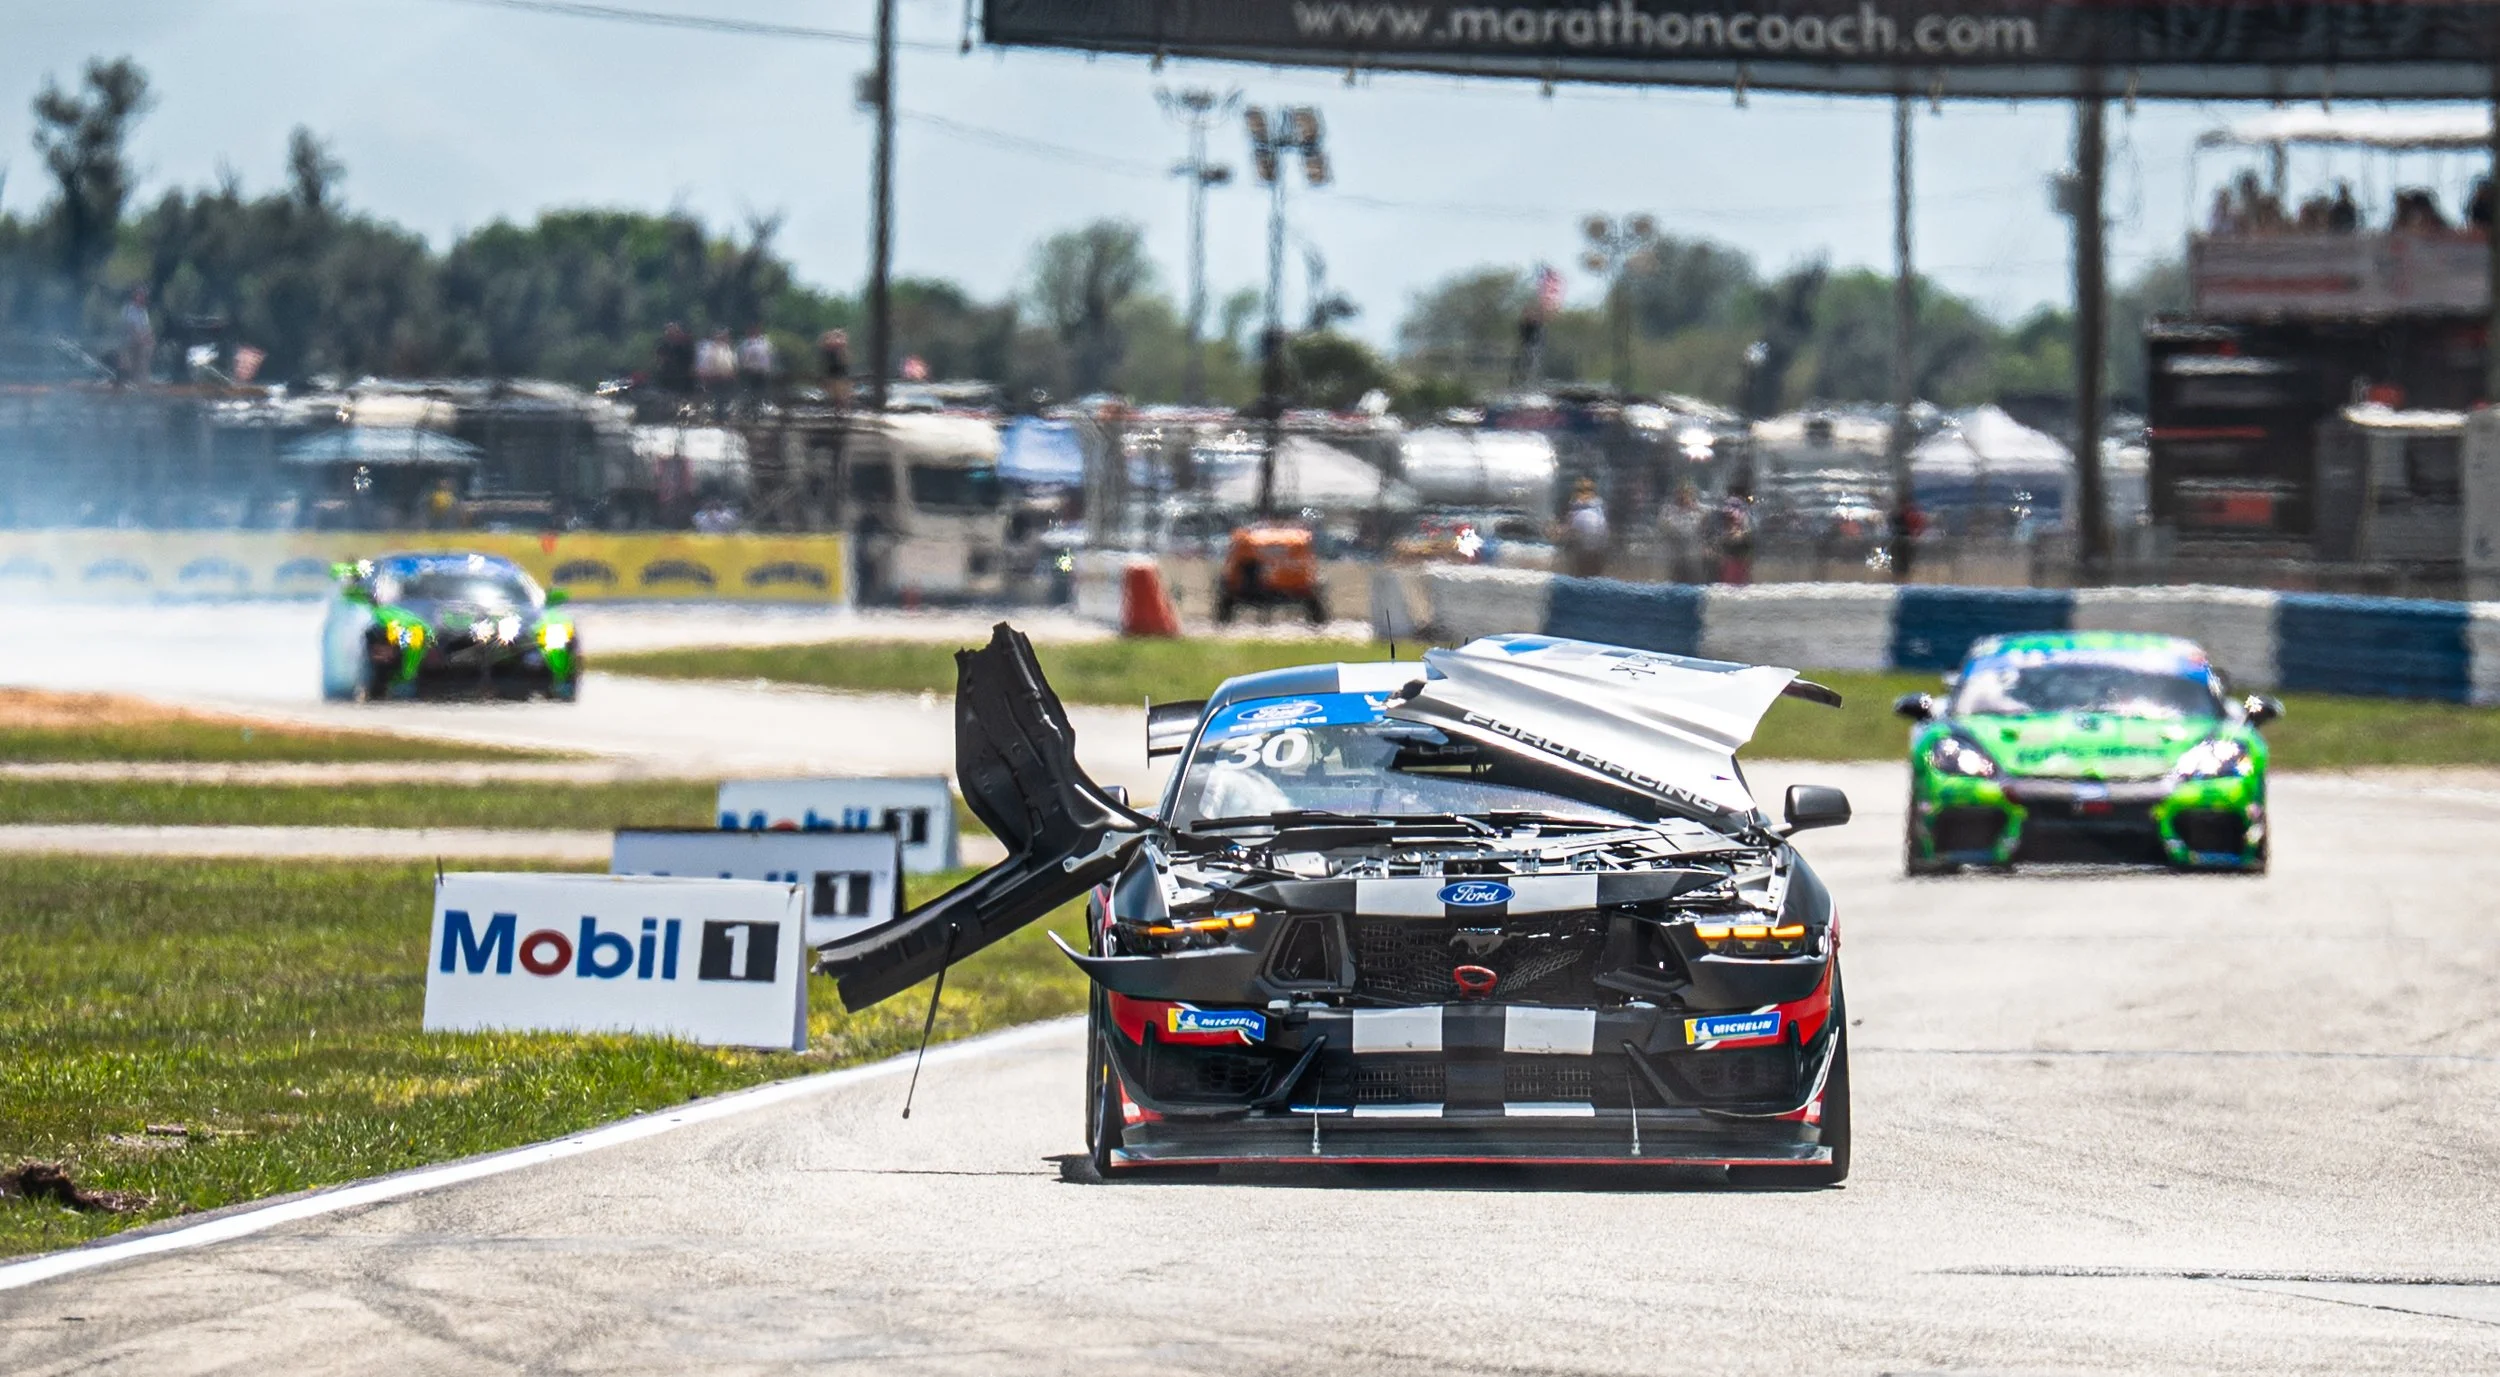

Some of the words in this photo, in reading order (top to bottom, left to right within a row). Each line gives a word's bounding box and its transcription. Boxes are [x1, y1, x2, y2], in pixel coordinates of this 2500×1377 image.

[1294, 1, 2037, 53] www.marathoncoach.com
[1214, 730, 1310, 770] 30
[1463, 711, 1571, 756] FORD
[1575, 751, 1720, 813] RACING
[1452, 884, 1500, 902] Ford
[440, 909, 681, 980] Mobil
[1201, 1017, 1260, 1030] MICHELIN
[1713, 1020, 1772, 1034] MICHELIN
